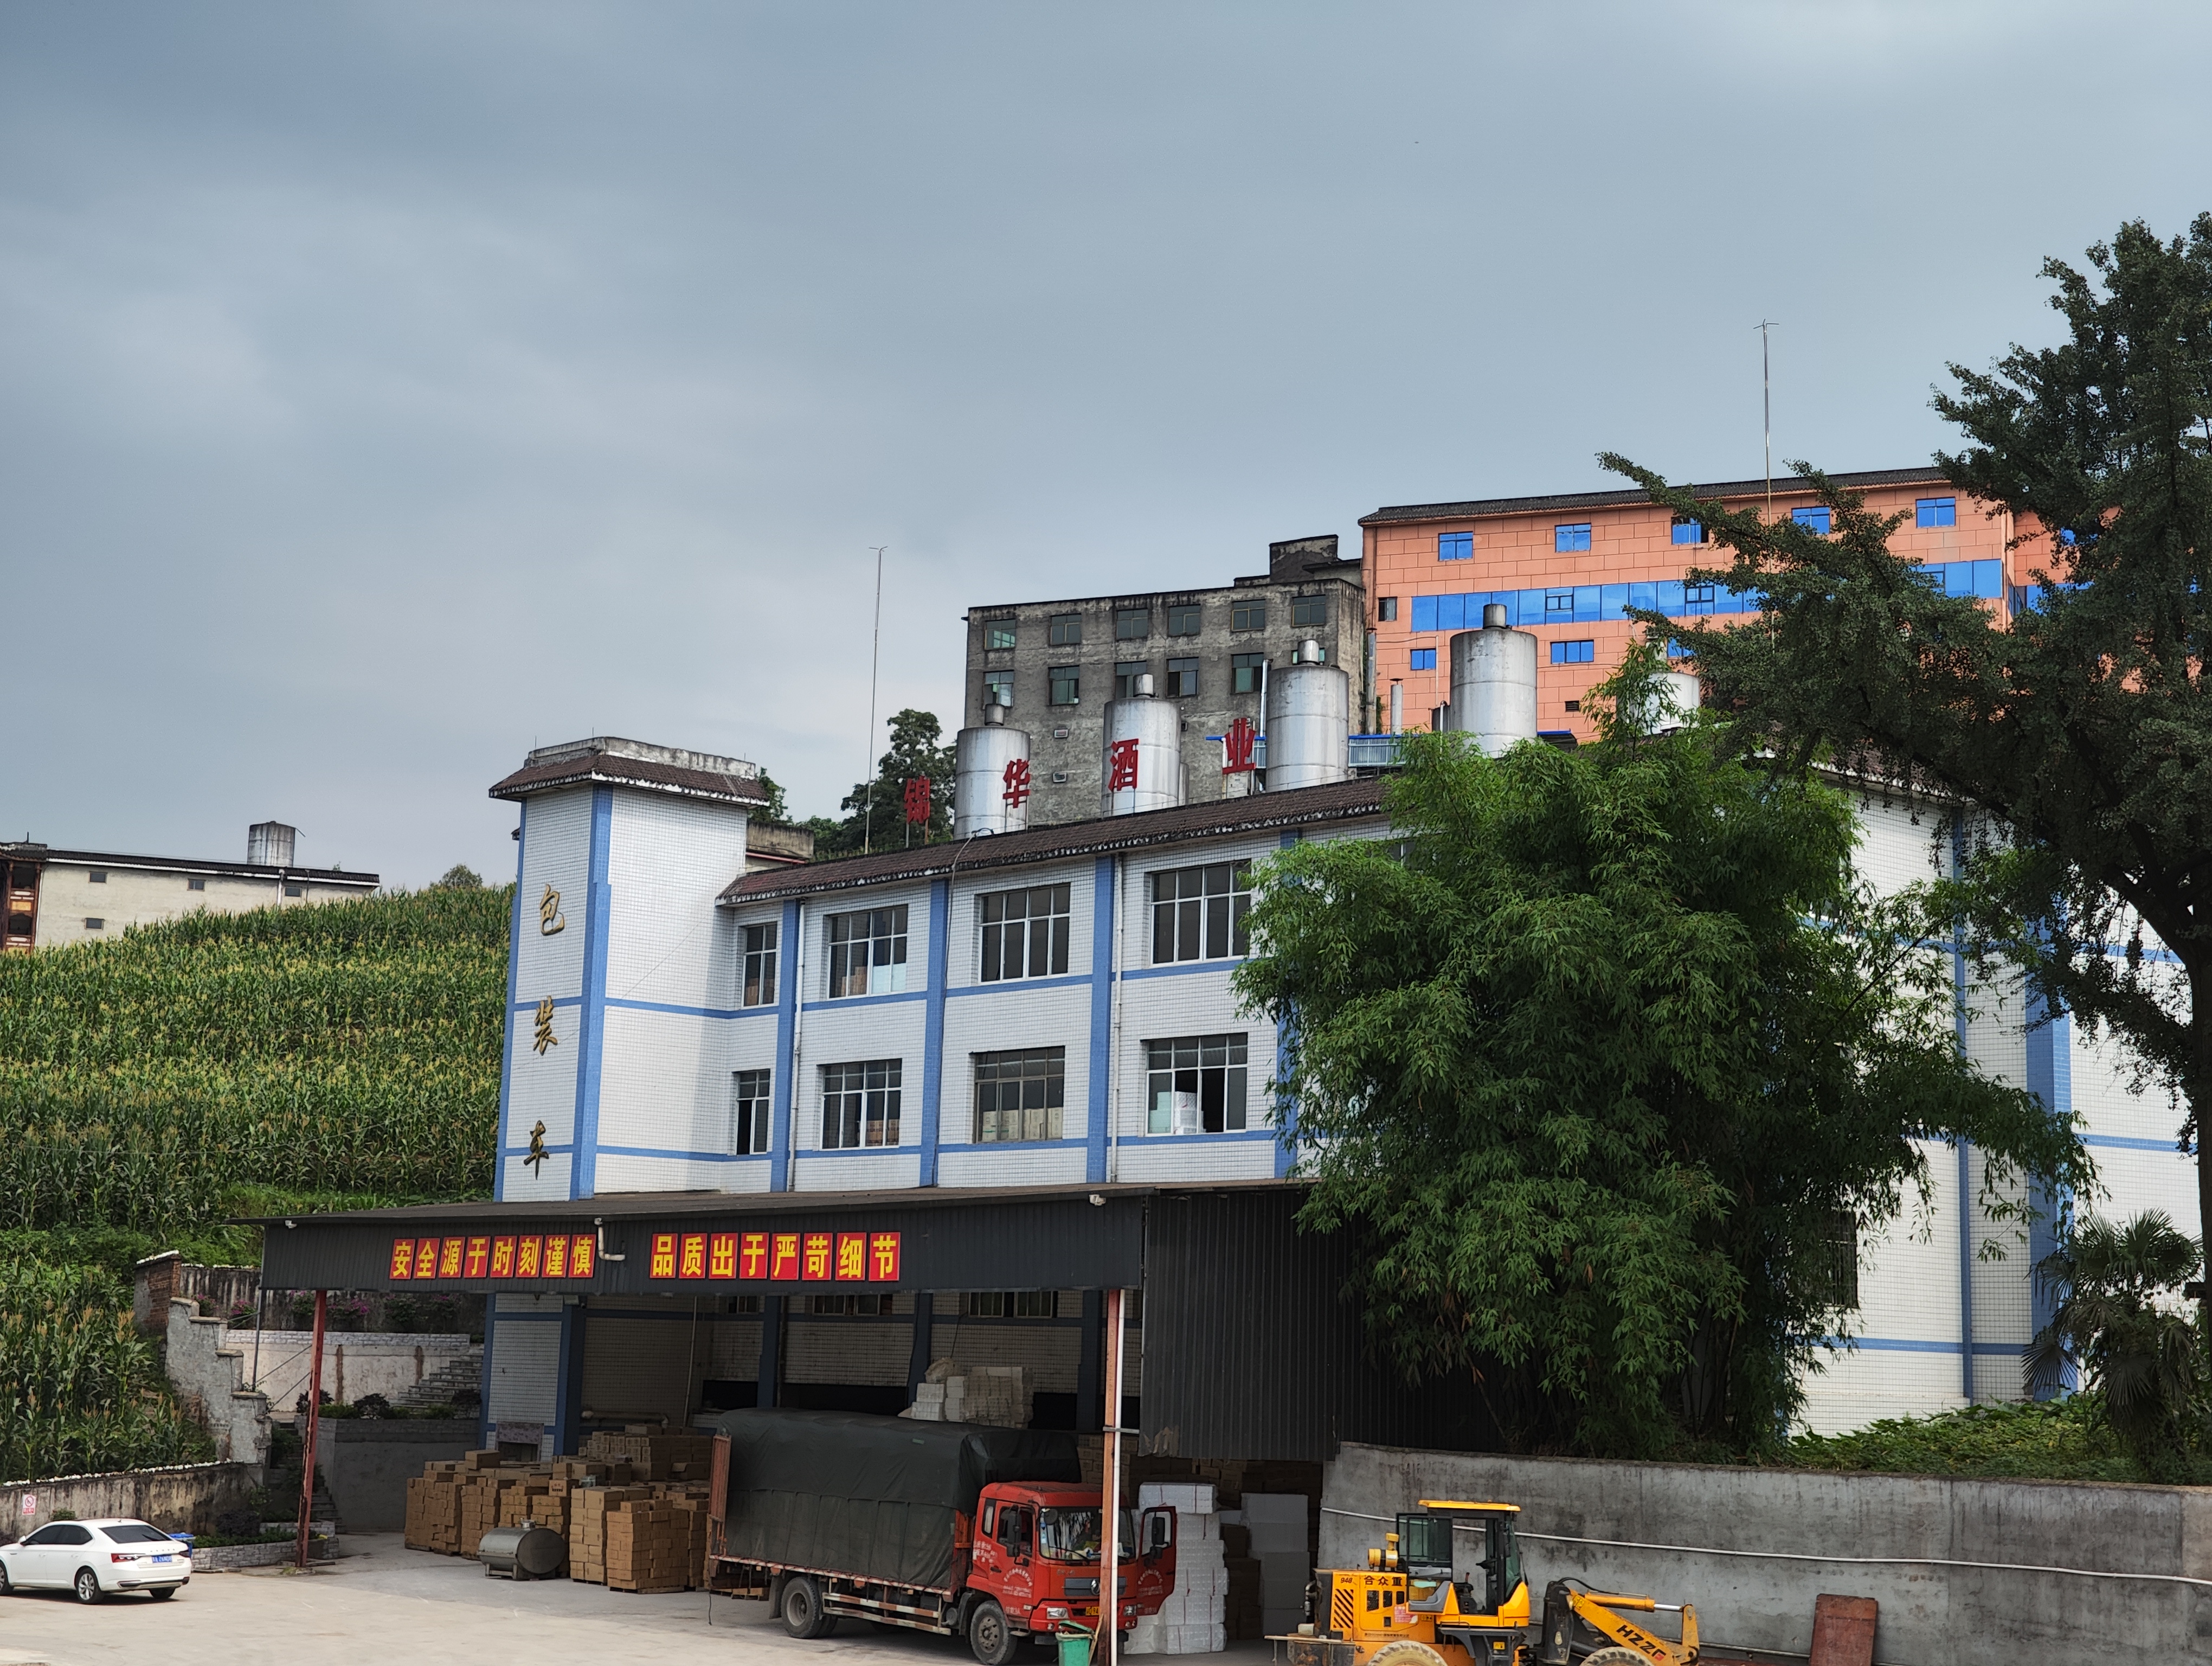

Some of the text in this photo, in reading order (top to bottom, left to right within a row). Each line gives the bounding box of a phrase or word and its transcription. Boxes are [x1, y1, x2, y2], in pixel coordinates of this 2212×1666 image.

[903, 717, 1256, 824] 锦华酒业
[523, 883, 565, 1180] 包装车
[393, 1236, 593, 1277] 安全源于时刻谨慎
[652, 1235, 896, 1278] 品质出于严苛细节
[1364, 1575, 1407, 1586] 合众重
